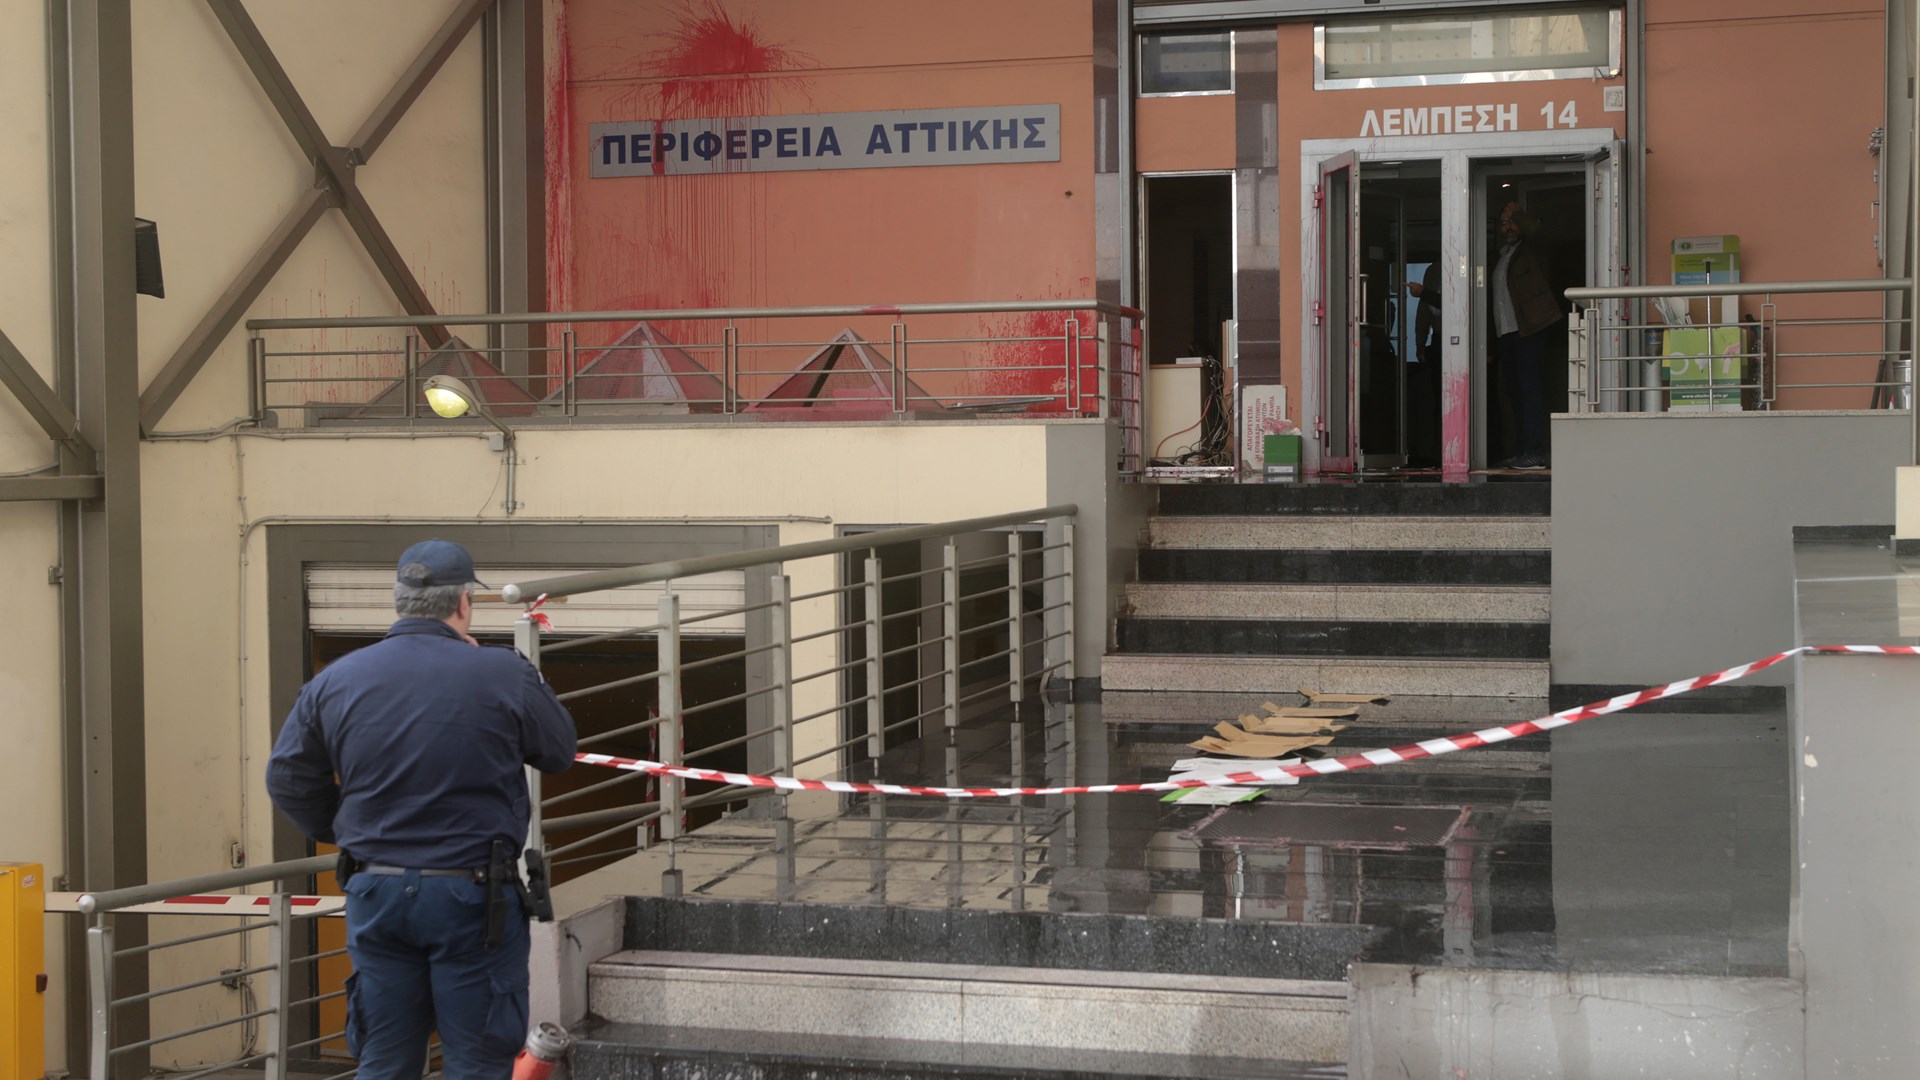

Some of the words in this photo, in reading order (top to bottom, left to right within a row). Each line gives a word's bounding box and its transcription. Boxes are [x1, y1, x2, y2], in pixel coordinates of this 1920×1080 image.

[1359, 103, 1518, 137] ΛΕΜΠΕΣΗ
[1540, 100, 1578, 129] 14
[602, 126, 842, 165] ΠΕΡΙΦΕΡΕΙΑ
[865, 117, 1046, 154] ΑΤΤΙΚΗΣ
